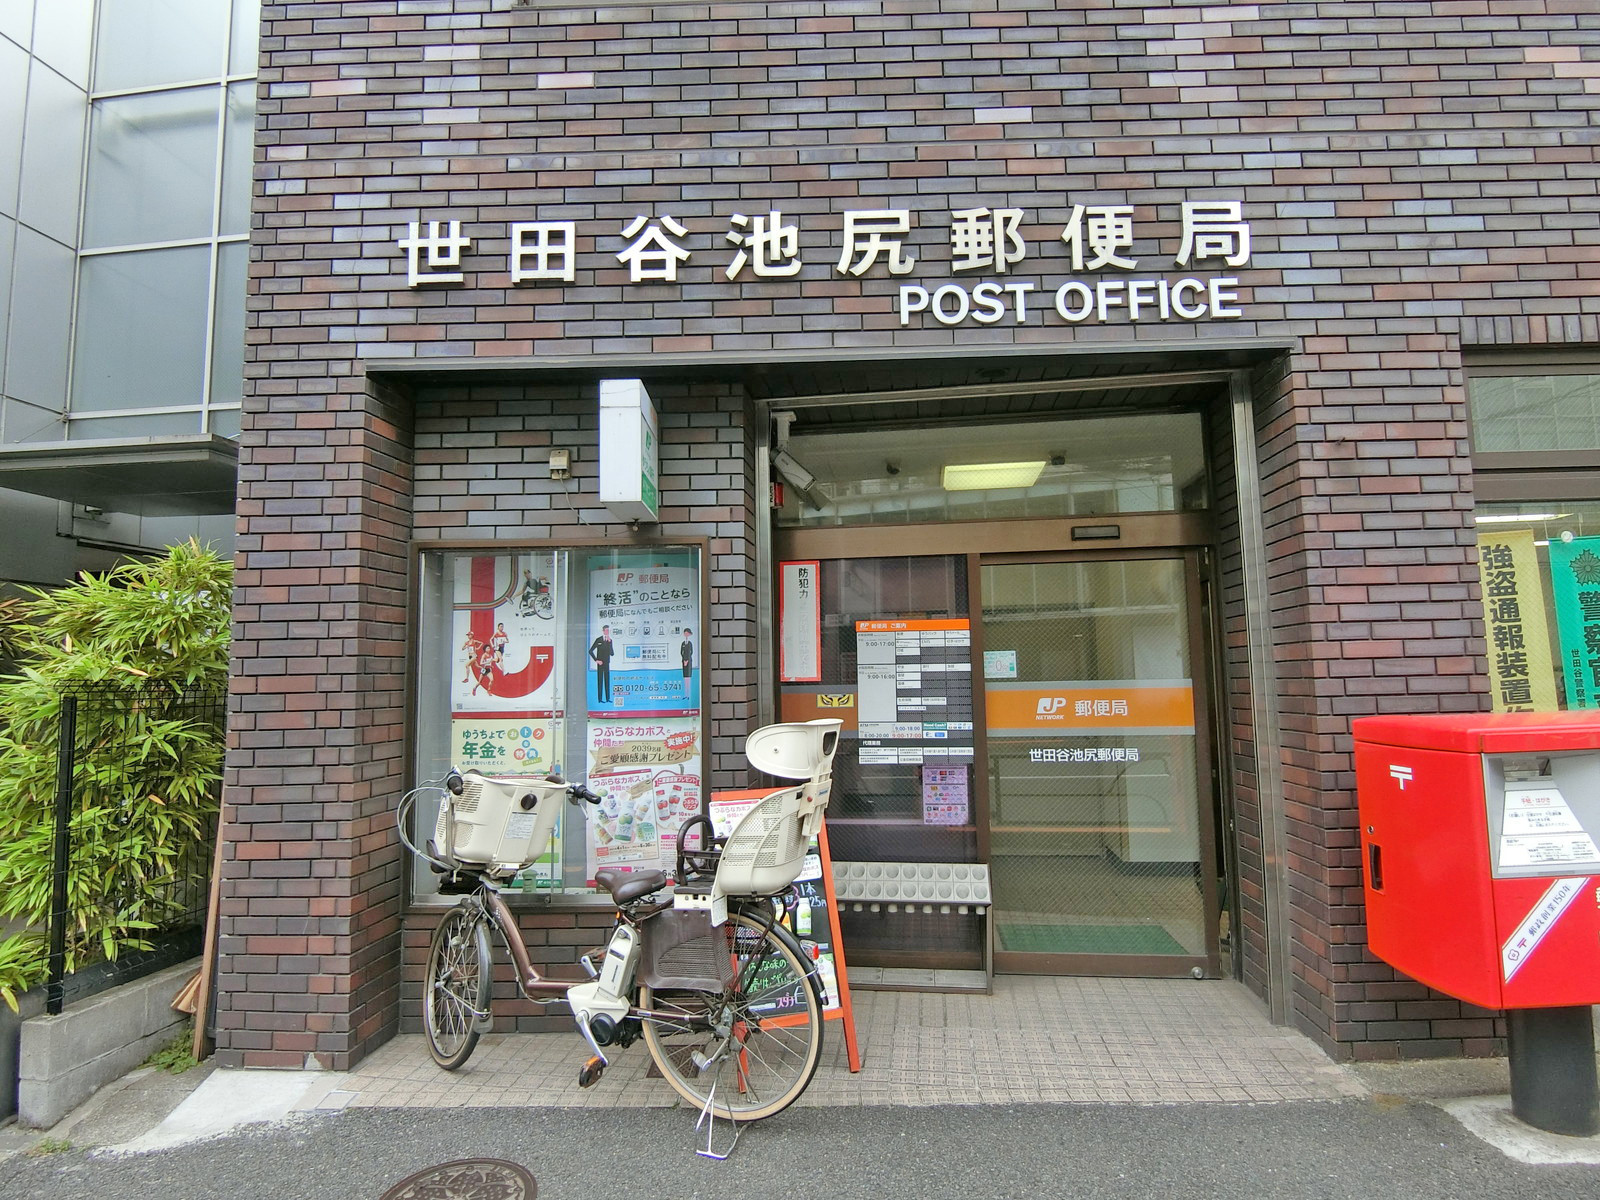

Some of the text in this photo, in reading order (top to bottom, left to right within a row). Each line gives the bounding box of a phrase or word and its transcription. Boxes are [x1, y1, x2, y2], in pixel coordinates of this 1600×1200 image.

[398, 201, 1250, 287] 世田谷池尻郵便局
[900, 276, 1243, 326] POST OFFICE
[638, 574, 669, 584] 郵便局
[599, 604, 692, 619] 郵便局になんでもご相談ください
[1075, 700, 1129, 717] 郵便局
[462, 729, 506, 740] ゆうちょで
[462, 741, 506, 759] 年金を
[593, 738, 625, 747] 仲間たち
[601, 749, 691, 765] ご愛顧感謝プレゼント
[1029, 748, 1139, 763] 世田谷池尻郵便局
